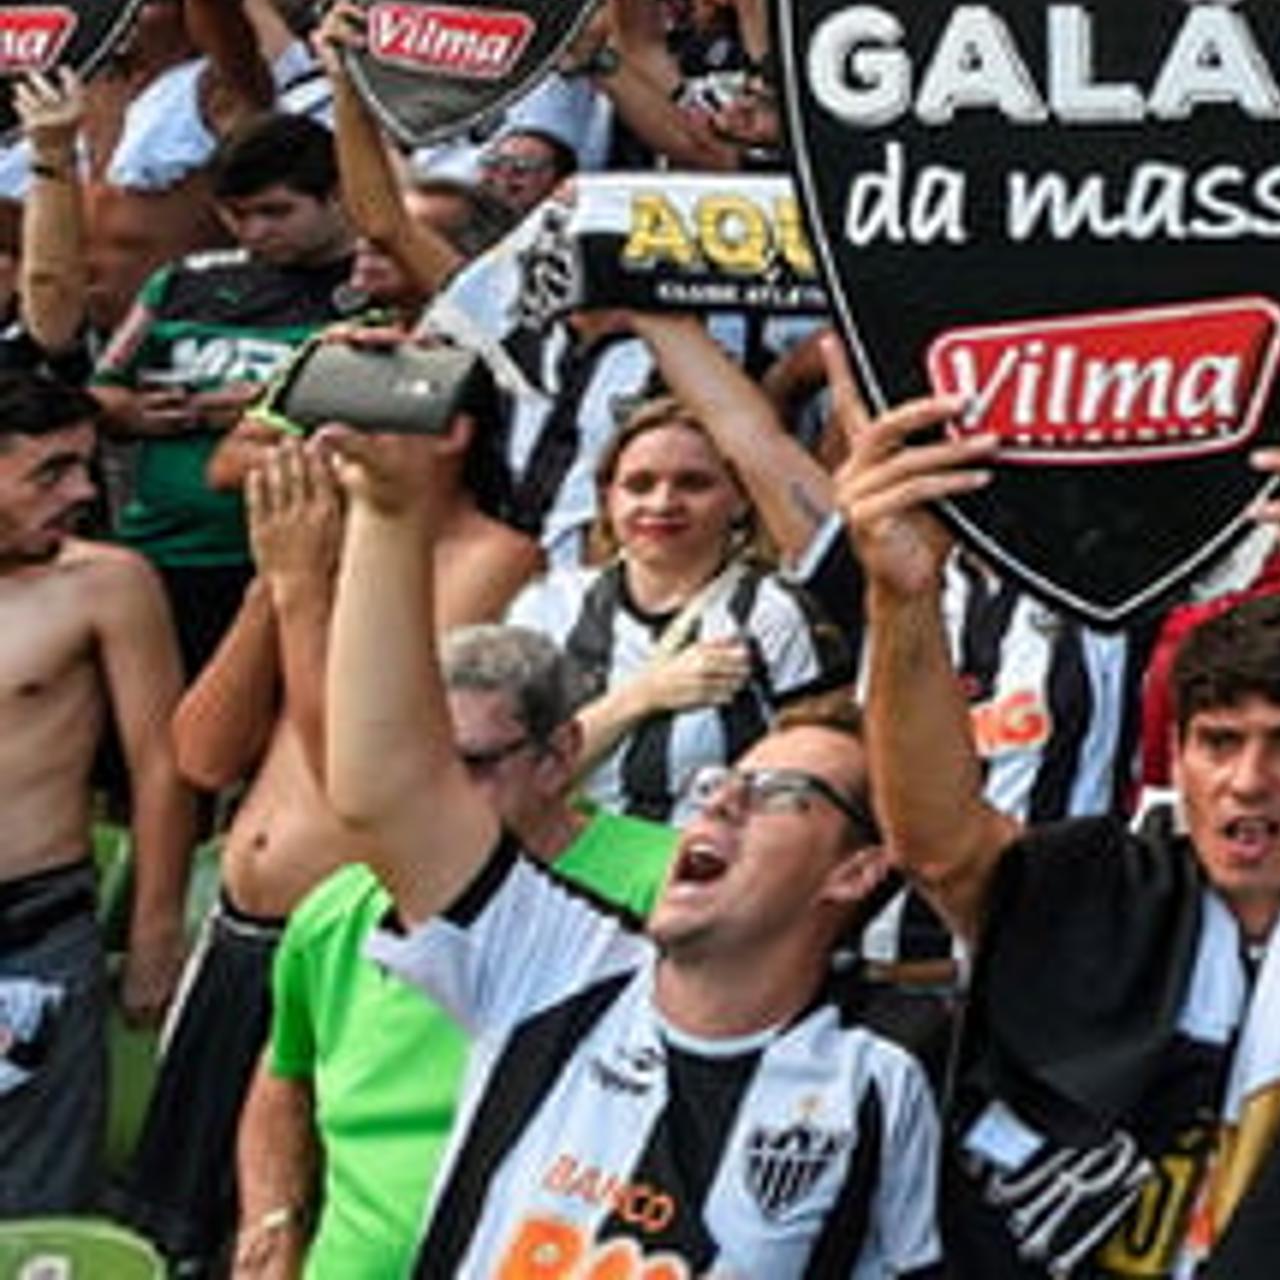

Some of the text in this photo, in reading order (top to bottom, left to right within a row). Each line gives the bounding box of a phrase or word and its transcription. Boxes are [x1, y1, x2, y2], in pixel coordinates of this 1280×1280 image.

[374, 5, 512, 64] Vilma
[846, 141, 966, 246] da
[950, 339, 1242, 429] Vilma
[541, 1152, 677, 1232] BANCO
